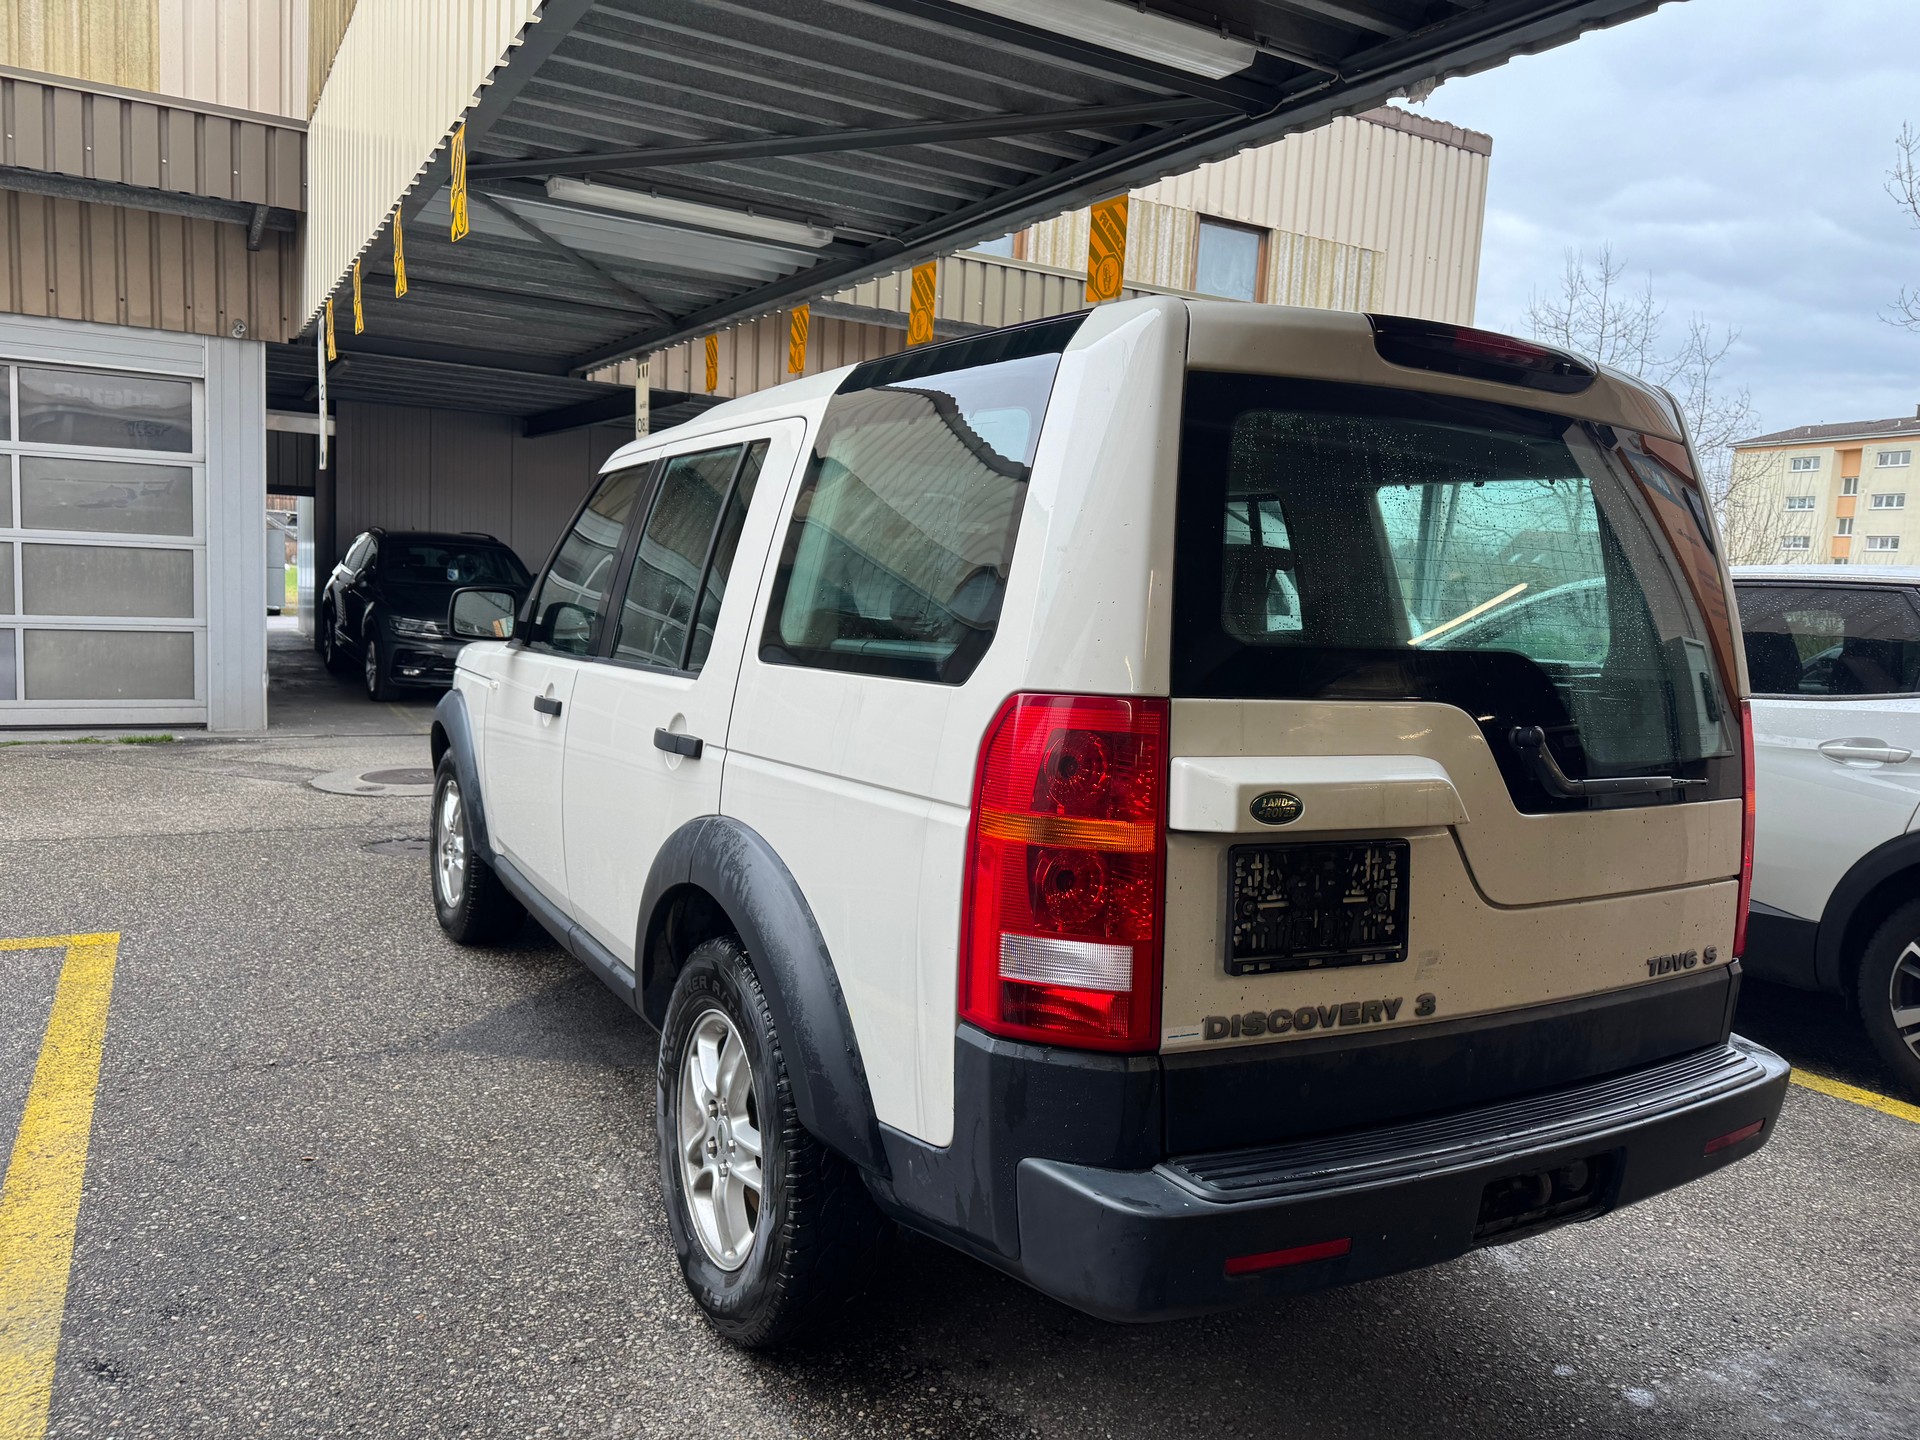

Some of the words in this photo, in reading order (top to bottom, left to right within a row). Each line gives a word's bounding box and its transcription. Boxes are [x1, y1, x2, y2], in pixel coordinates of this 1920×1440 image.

[1262, 797, 1288, 808] LAND
[1265, 807, 1296, 818] ROVER
[1647, 948, 1698, 977] TDV6
[1703, 944, 1717, 965] S
[1204, 996, 1403, 1040] DISCOVERY
[1415, 992, 1437, 1017] 3
